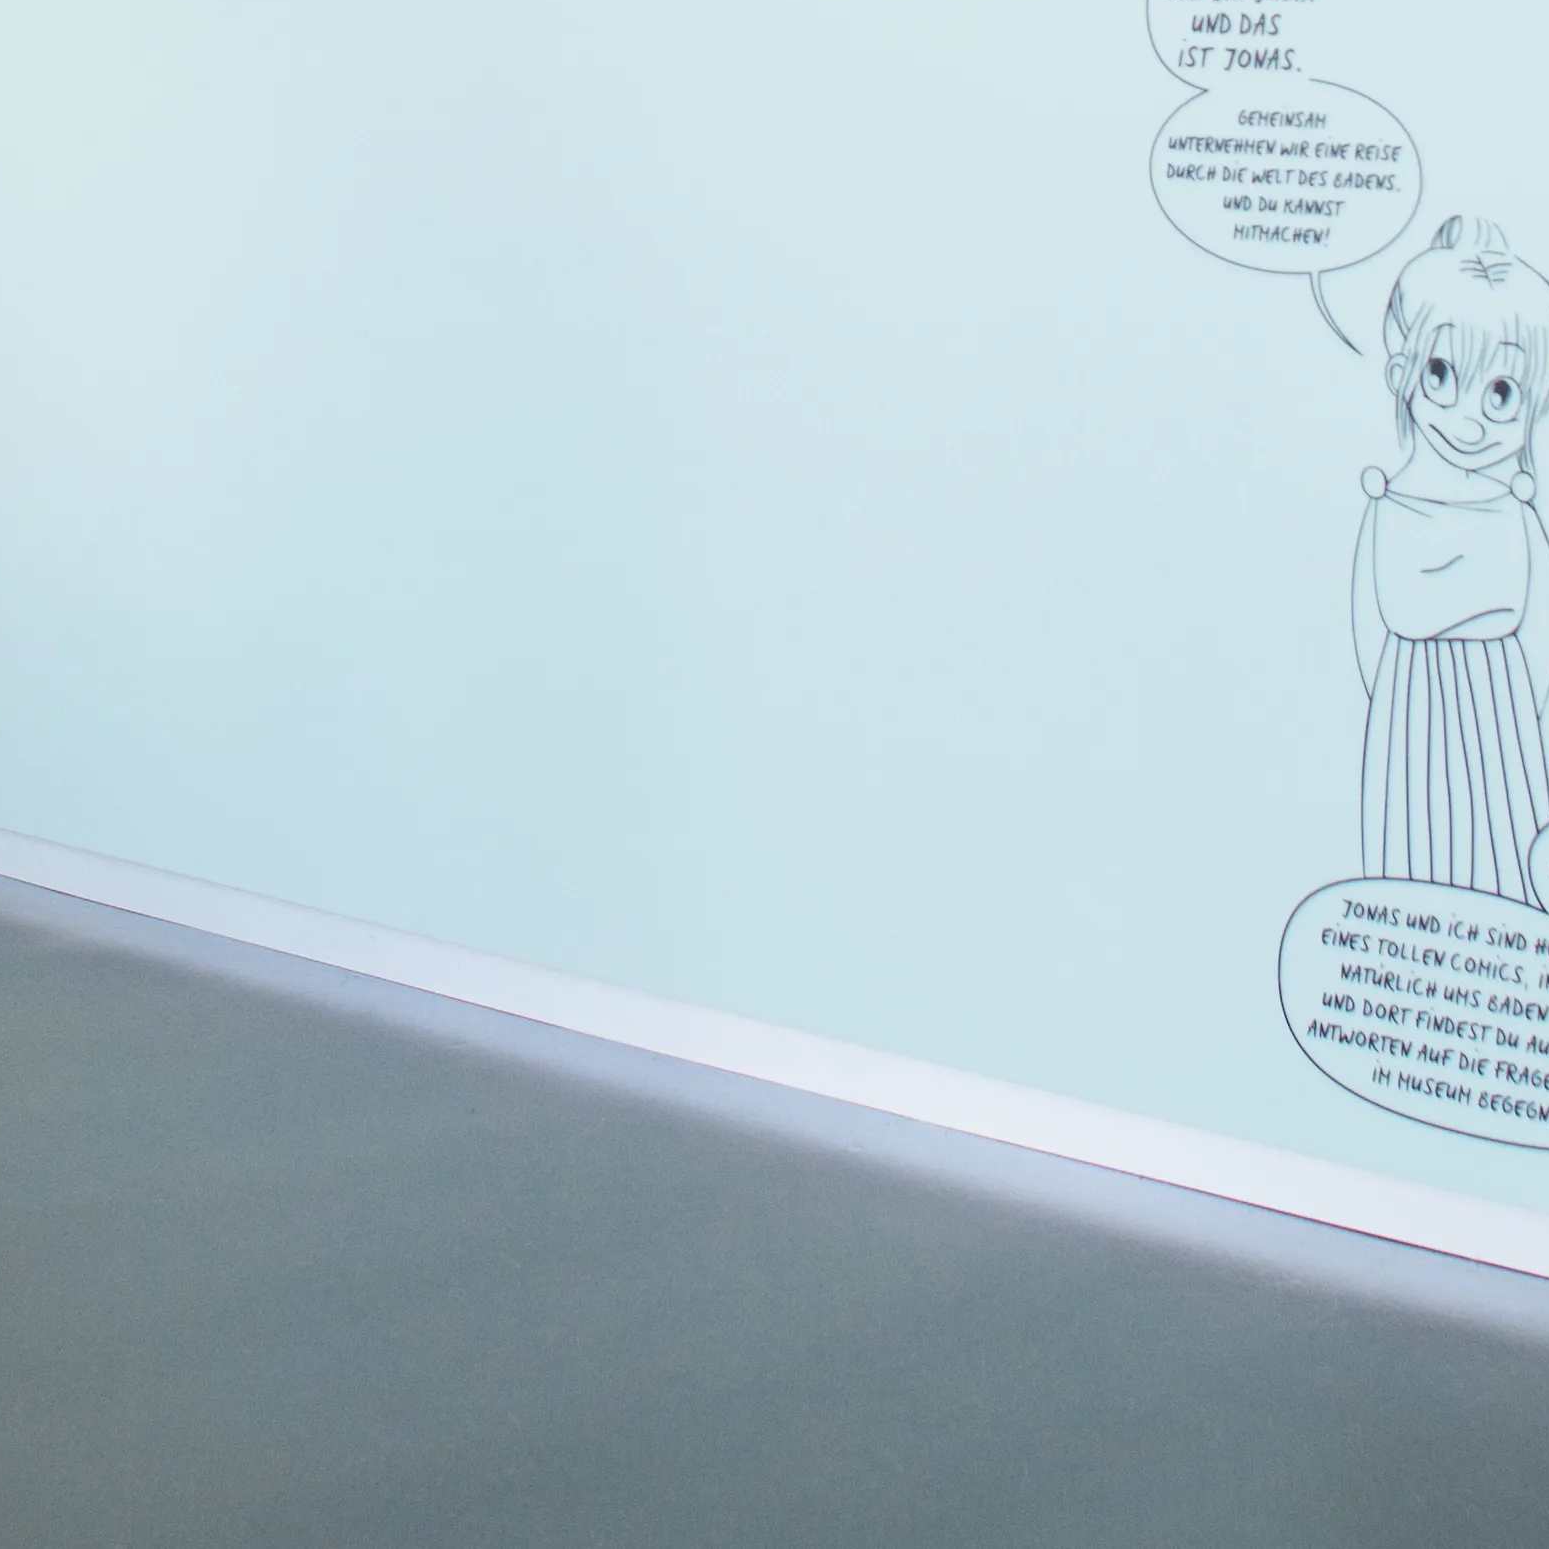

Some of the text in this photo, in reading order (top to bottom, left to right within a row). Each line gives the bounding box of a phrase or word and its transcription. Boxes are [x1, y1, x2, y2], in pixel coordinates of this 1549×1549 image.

[1192, 13, 1282, 36] UND DAS
[1178, 38, 1302, 72] IST JONAS.
[1342, 899, 1400, 926] JONAS
[1407, 915, 1440, 934] UND
[1449, 913, 1479, 942] ICH
[1485, 923, 1527, 950] SIND
[1321, 923, 1370, 953] EINES
[1378, 938, 1445, 967] TOLLEN
[1450, 953, 1529, 990] COMICS,
[1340, 963, 1437, 999] NATÜRLICH
[1443, 987, 1479, 1008] UMS
[1487, 996, 1549, 1022] BADEN
[1323, 992, 1355, 1013] UND
[1363, 1000, 1412, 1026] DORT
[1416, 1007, 1492, 1042] FINDEST
[1496, 1028, 1519, 1047] DU
[1307, 1018, 1413, 1058] ANTWORTEN
[1416, 1045, 1452, 1070] AUF
[1458, 1049, 1486, 1076] DIE
[1372, 1060, 1391, 1085] IM
[1397, 1070, 1471, 1104] MUSEUM
